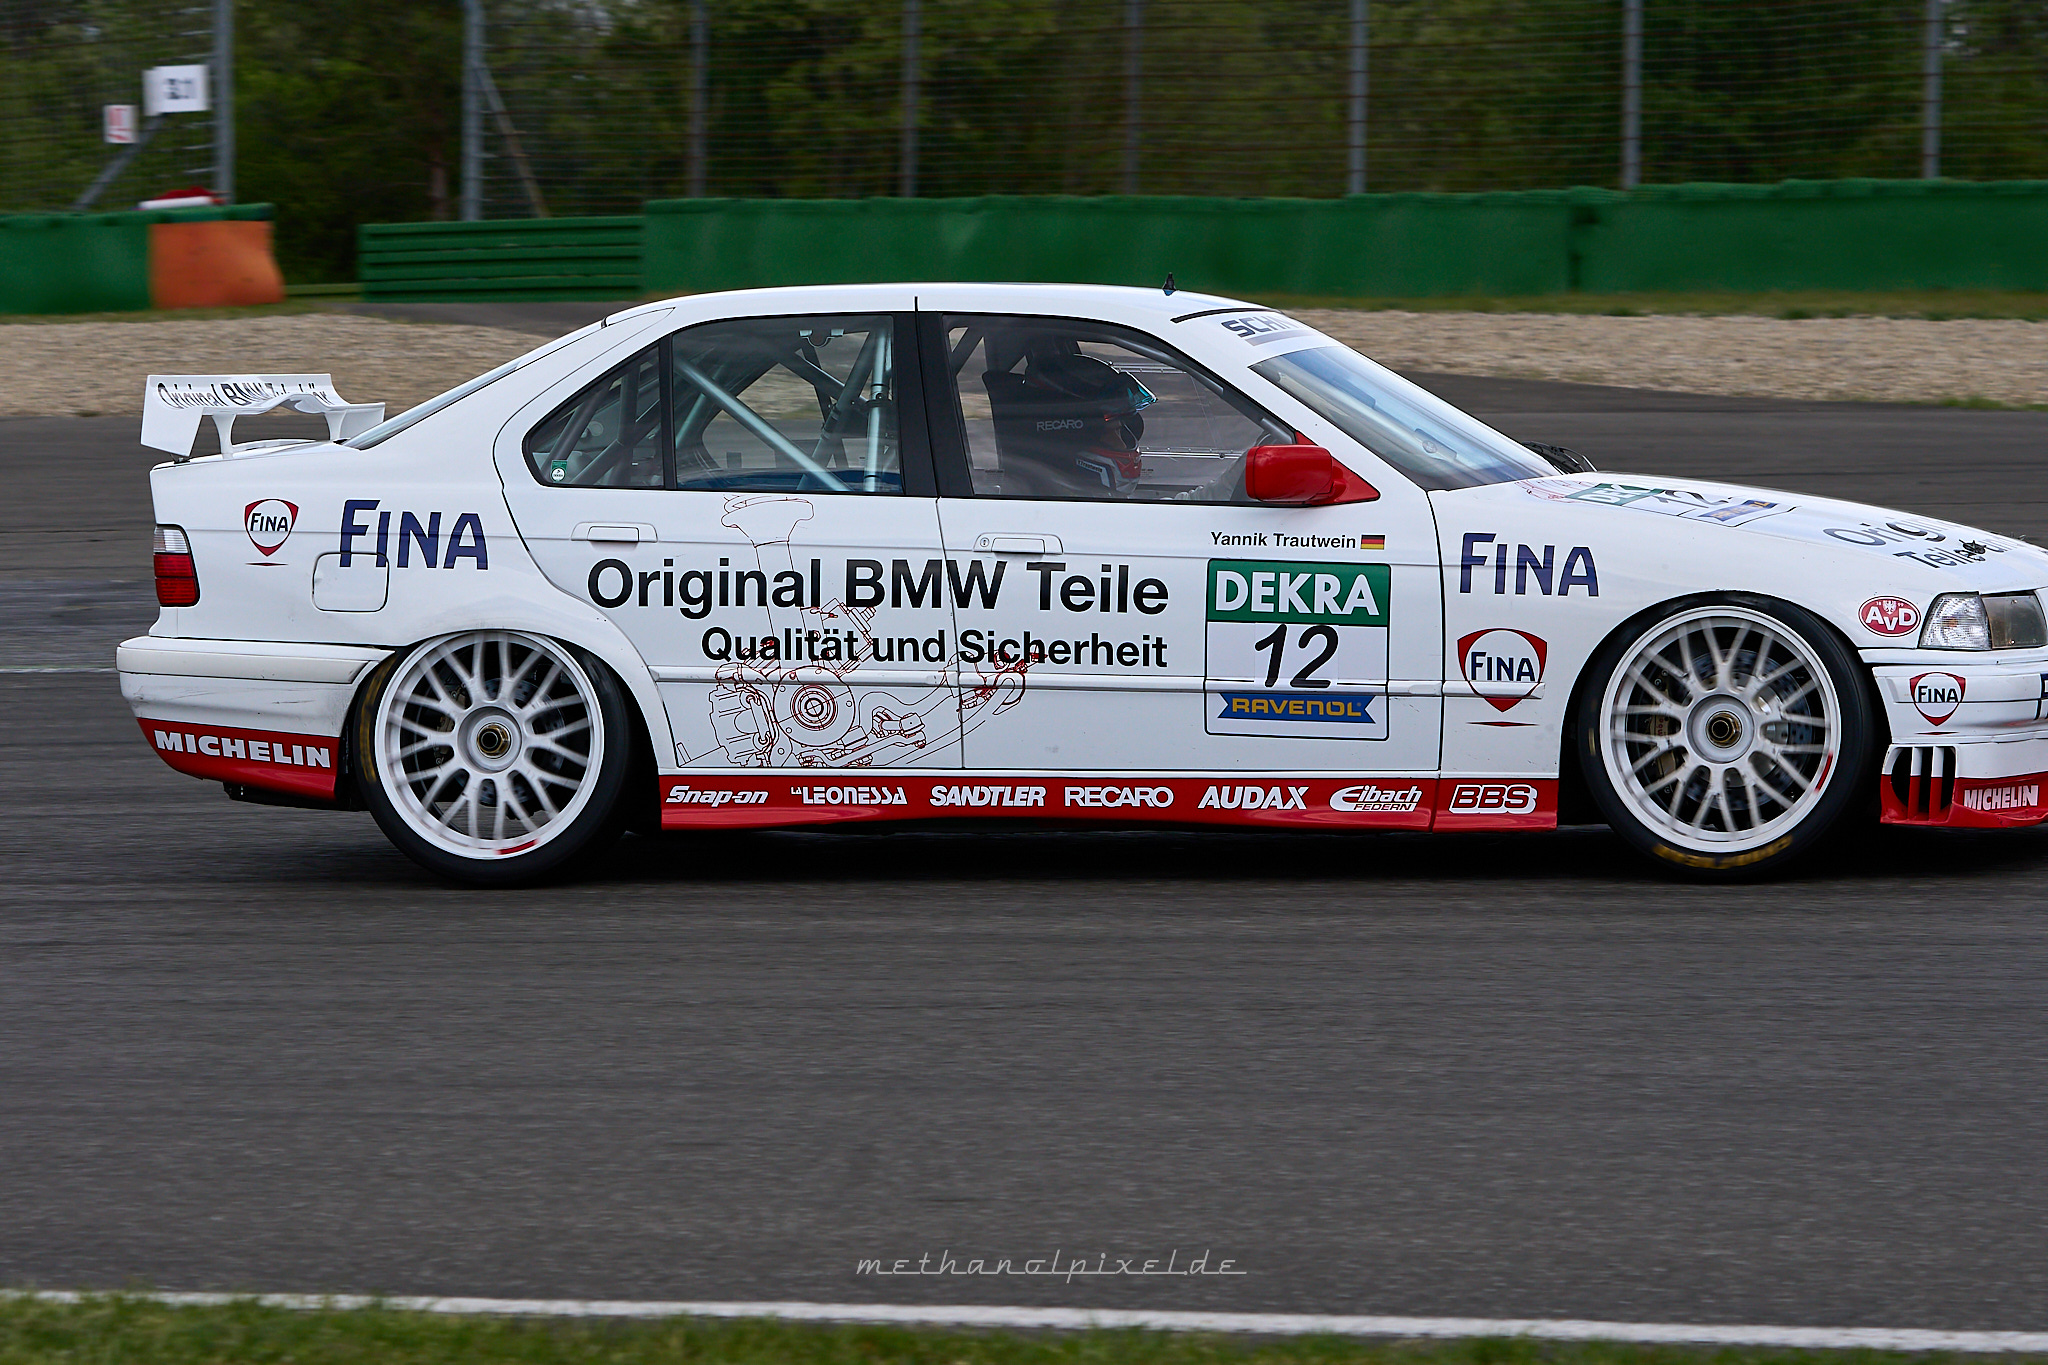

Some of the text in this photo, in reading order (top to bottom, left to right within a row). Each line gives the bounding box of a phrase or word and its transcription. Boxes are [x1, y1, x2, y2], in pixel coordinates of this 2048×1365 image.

[1036, 419, 1084, 432] RECARO
[250, 512, 289, 532] FINA
[339, 499, 488, 570] FINA
[1210, 531, 1356, 549] Yannik Trautwein
[1459, 532, 1599, 597] FINA
[587, 558, 1169, 619] Original BMW Teile
[1215, 570, 1380, 616] DEKRA
[701, 626, 1168, 668] Qualität und Sicherheit
[1254, 623, 1339, 688] 12
[1471, 651, 1536, 682] FINA
[1231, 697, 1362, 717] RAVENOL
[1917, 685, 1959, 703] FINA
[153, 729, 331, 768] MICHELIN
[665, 784, 770, 808] Snap-on
[929, 784, 1048, 808] SANDTLER
[1063, 786, 1175, 808] RECARO
[1197, 785, 1309, 811] AUDAX
[1329, 784, 1423, 811] Eibach
[1352, 802, 1414, 811] FEDERN
[1449, 783, 1539, 815] BBS
[1963, 784, 2040, 811] MICHELIN
